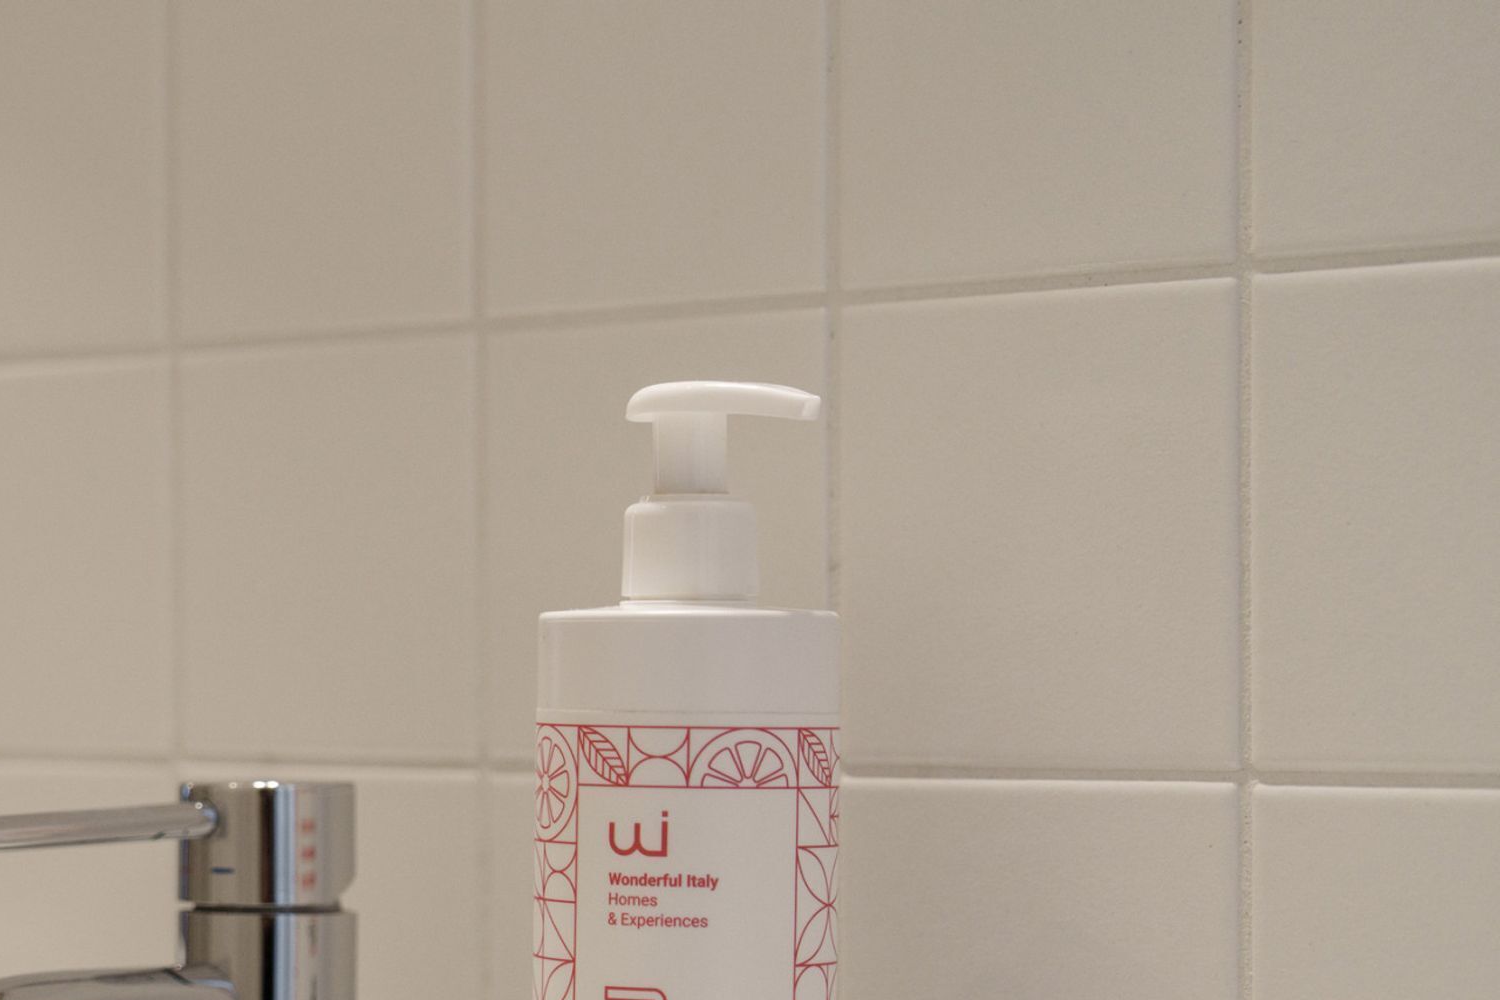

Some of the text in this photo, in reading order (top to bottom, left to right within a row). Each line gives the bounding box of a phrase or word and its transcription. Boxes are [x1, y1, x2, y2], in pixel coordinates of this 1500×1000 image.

[608, 872, 719, 891] Wonderful Italy
[607, 892, 658, 906] Homes
[607, 912, 708, 929] & Experiences
